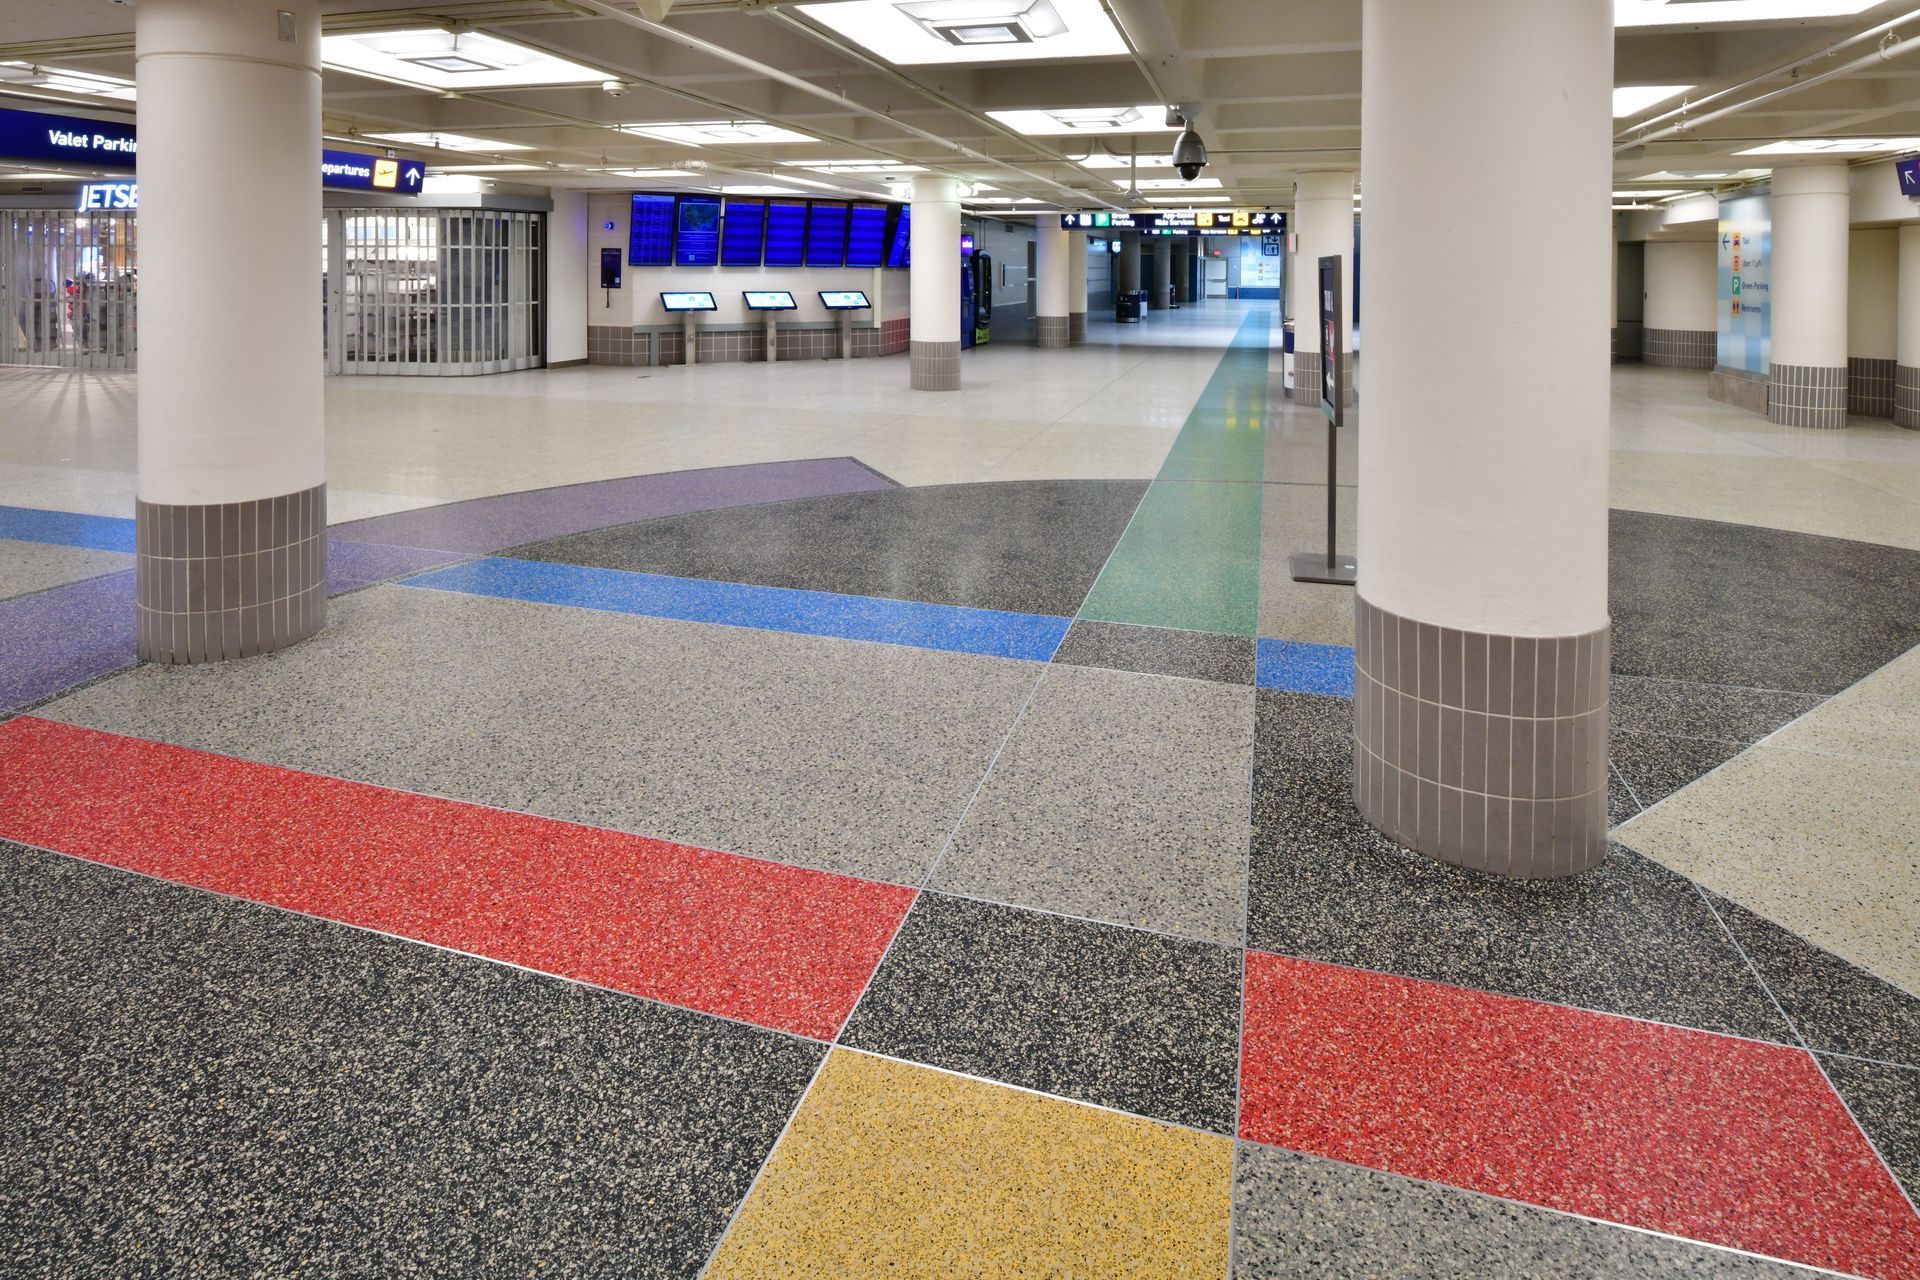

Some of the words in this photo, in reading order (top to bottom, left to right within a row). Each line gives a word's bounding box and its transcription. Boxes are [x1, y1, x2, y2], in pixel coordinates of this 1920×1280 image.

[48, 129, 88, 148] Valet
[1111, 219, 1135, 227] Parking
[1754, 282, 1769, 292] Parking
[1741, 304, 1761, 313] Restrooms
